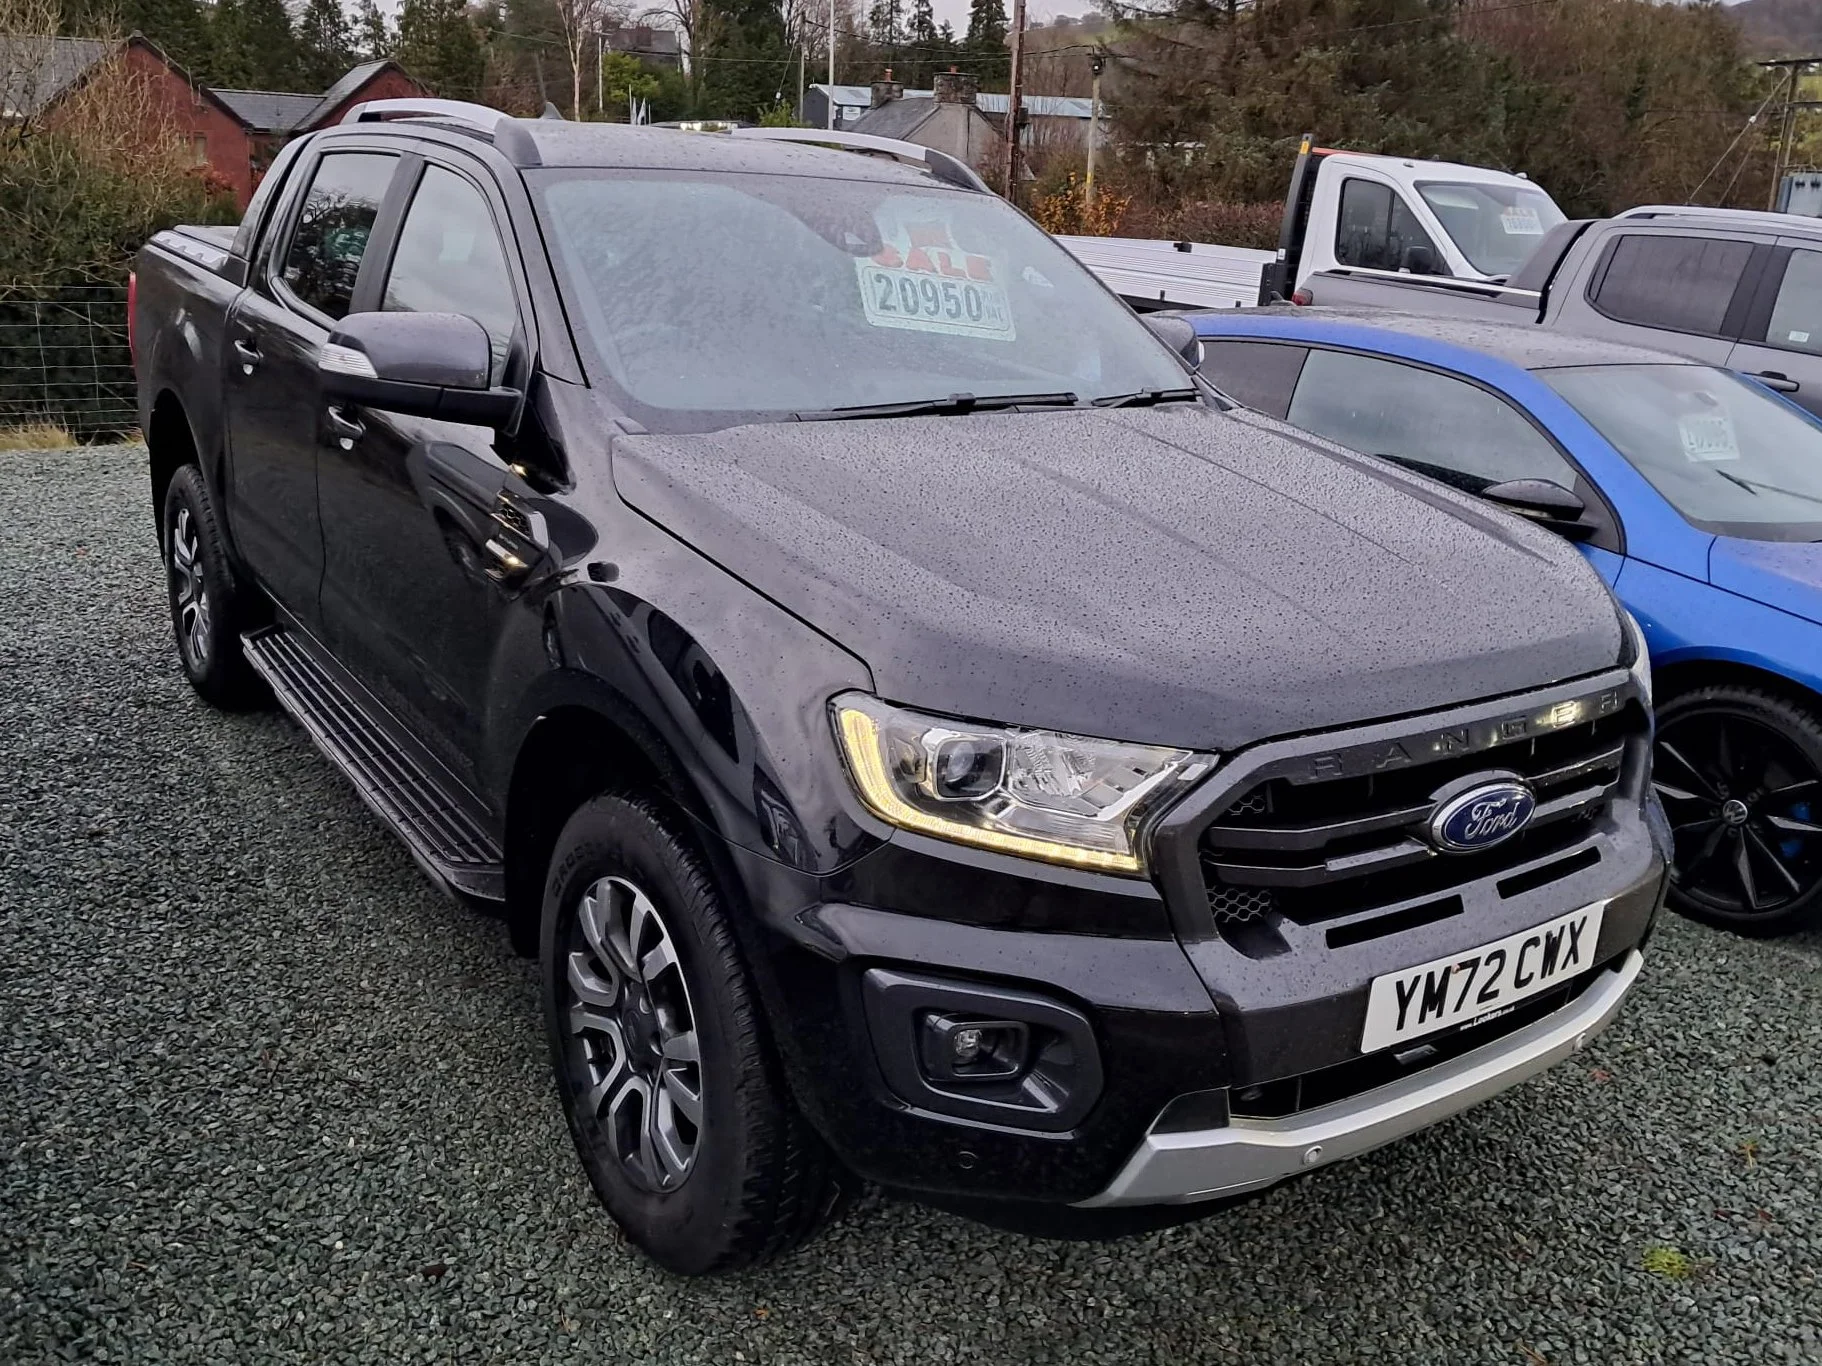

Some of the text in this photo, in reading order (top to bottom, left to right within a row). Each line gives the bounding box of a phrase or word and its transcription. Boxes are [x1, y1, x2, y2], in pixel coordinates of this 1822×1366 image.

[874, 273, 983, 321] 20950
[1308, 690, 1618, 780] RANGER
[1464, 799, 1519, 841] Ford
[1395, 916, 1588, 1031] YM72 CWX
